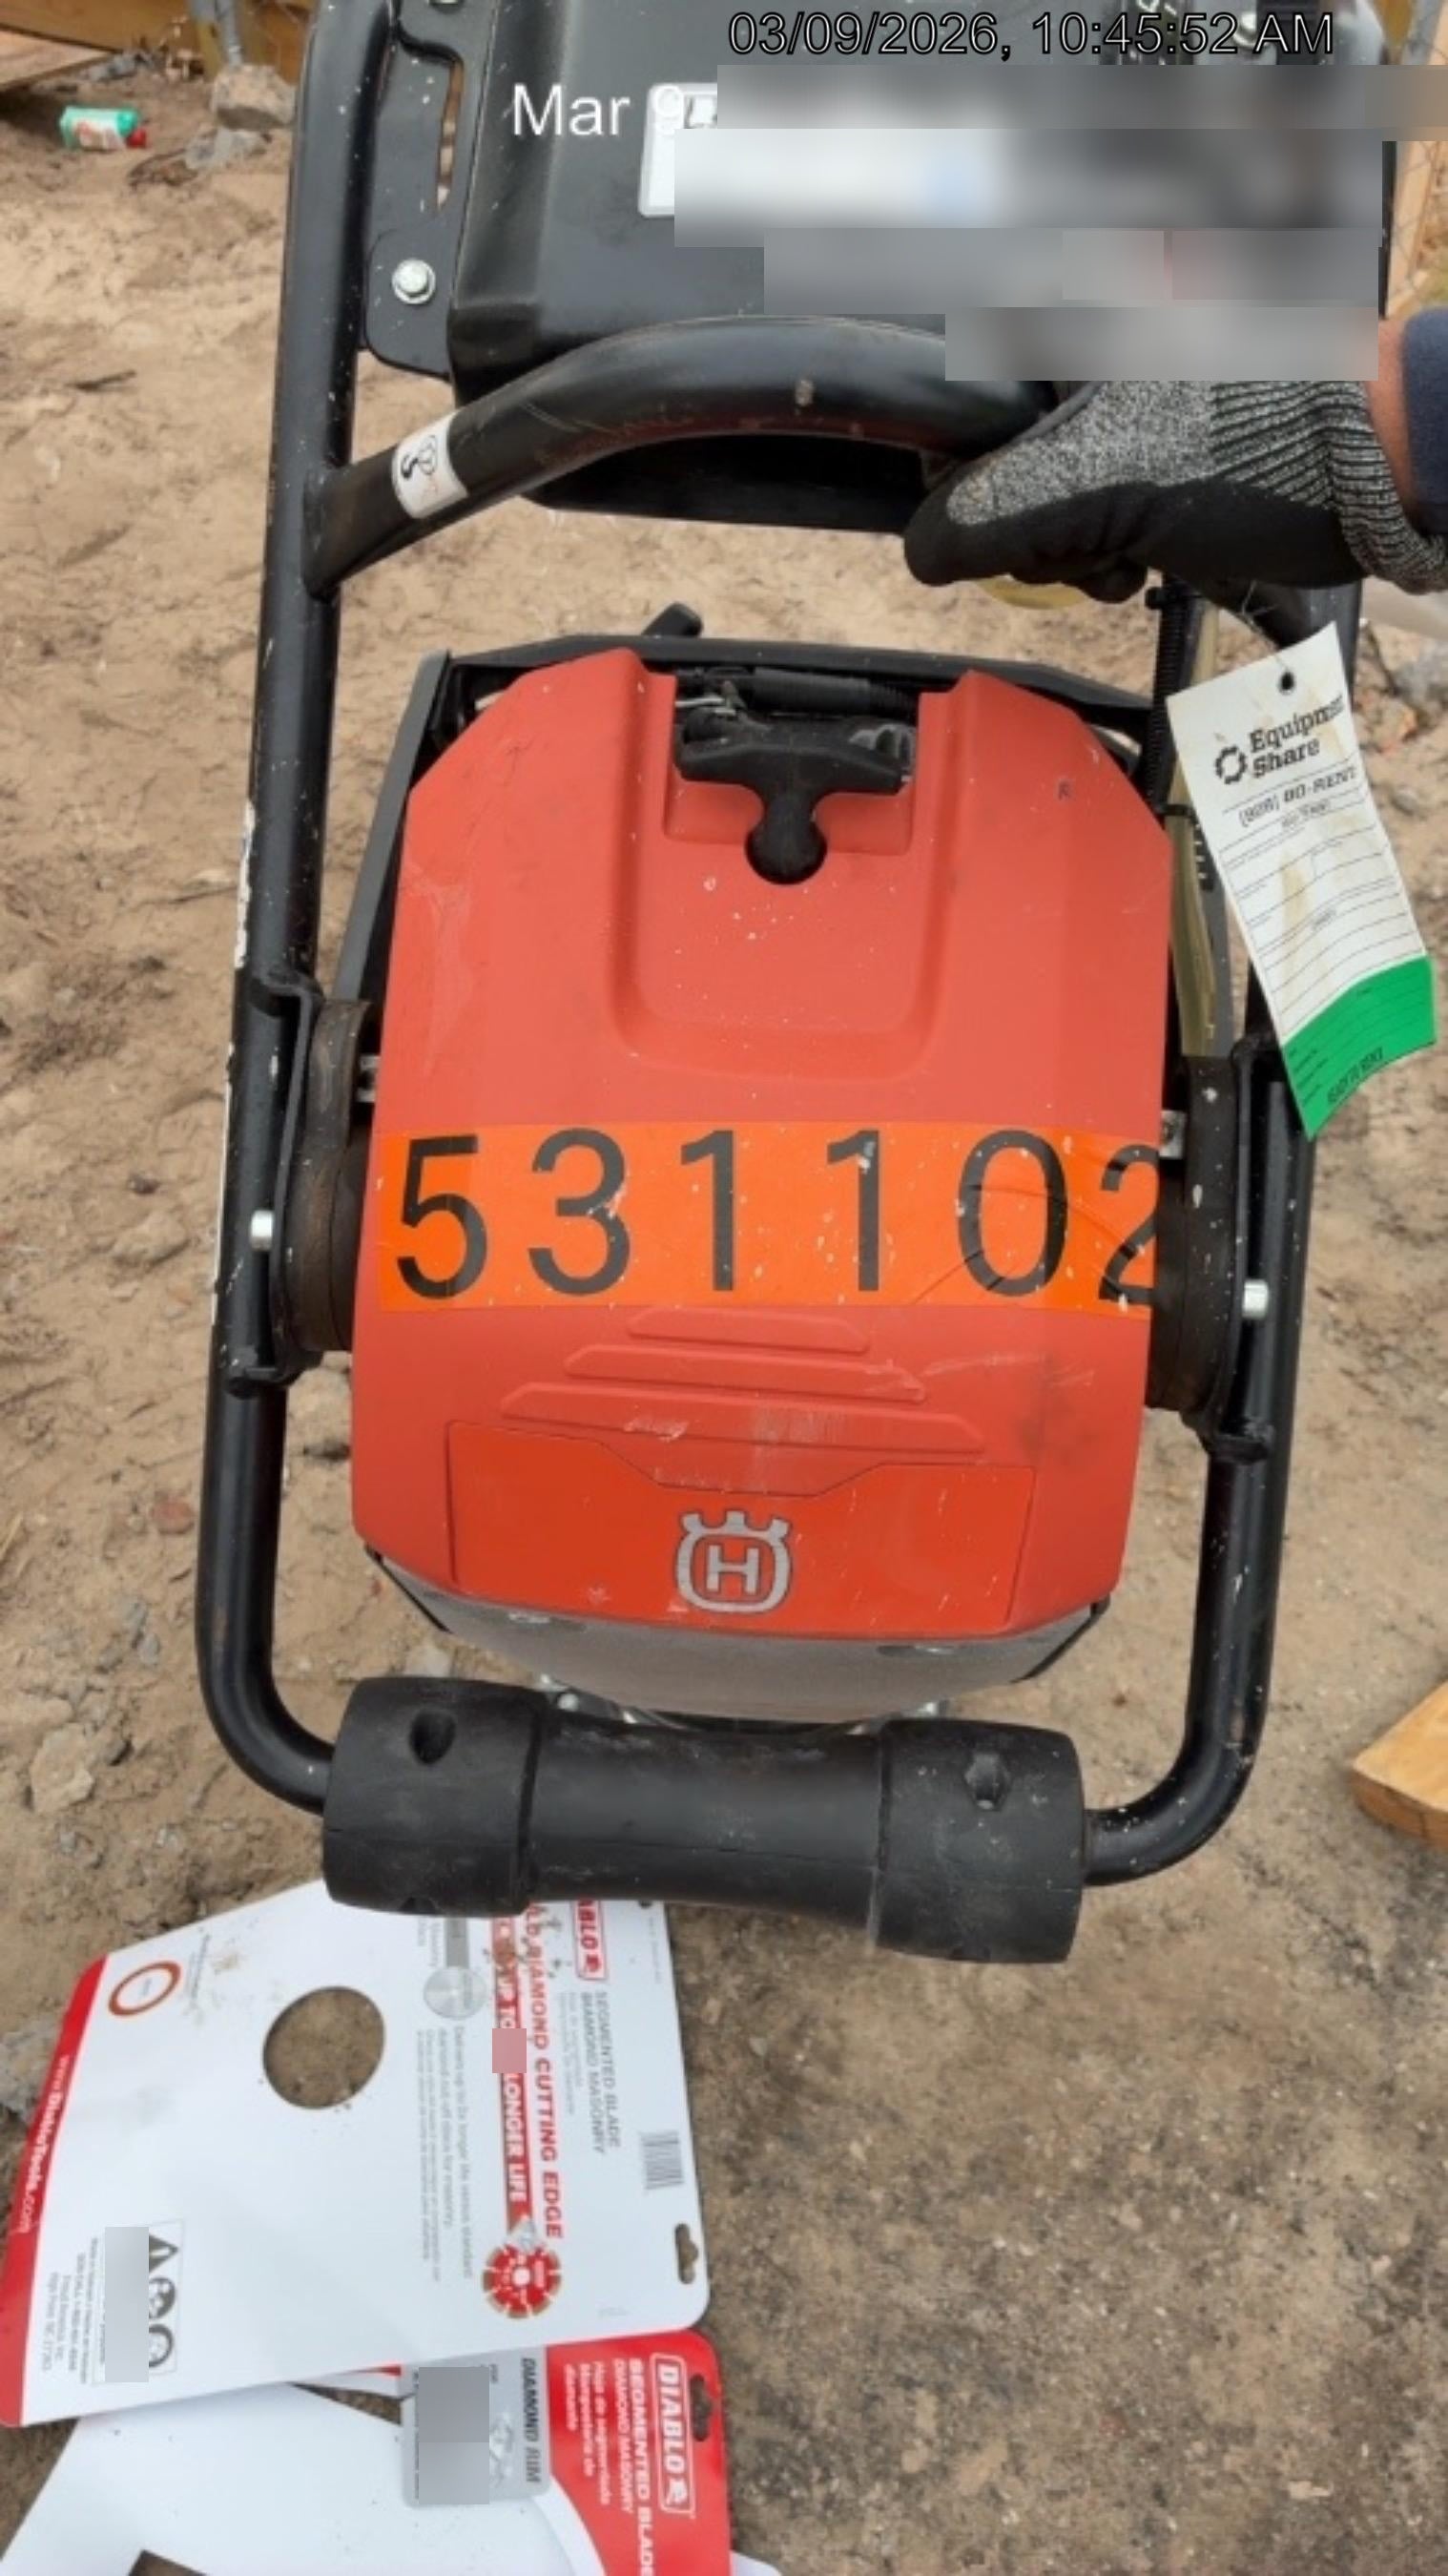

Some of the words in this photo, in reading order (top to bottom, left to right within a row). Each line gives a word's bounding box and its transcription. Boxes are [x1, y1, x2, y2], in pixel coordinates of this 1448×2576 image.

[1253, 738, 1320, 779] Share
[395, 1127, 1160, 1305] 531102
[527, 1946, 550, 2050] DIAMOND
[581, 1991, 600, 2067] DIAMOND
[597, 1991, 616, 2088] SEGMENTED
[504, 2073, 526, 2156] LONGER
[534, 2059, 558, 2162] CUTTING
[590, 2071, 607, 2155] MASONRY
[606, 2092, 622, 2148] BLADE
[507, 2164, 528, 2203] LIFE
[543, 2171, 564, 2239] EDGE
[521, 2358, 540, 2442] DIAMOND
[613, 2358, 630, 2434] DIAMOND
[628, 2358, 652, 2500] SEGMENTED
[657, 2364, 686, 2474] DIABLO
[525, 2446, 543, 2483] RIM
[619, 2436, 634, 2513] MASONRY
